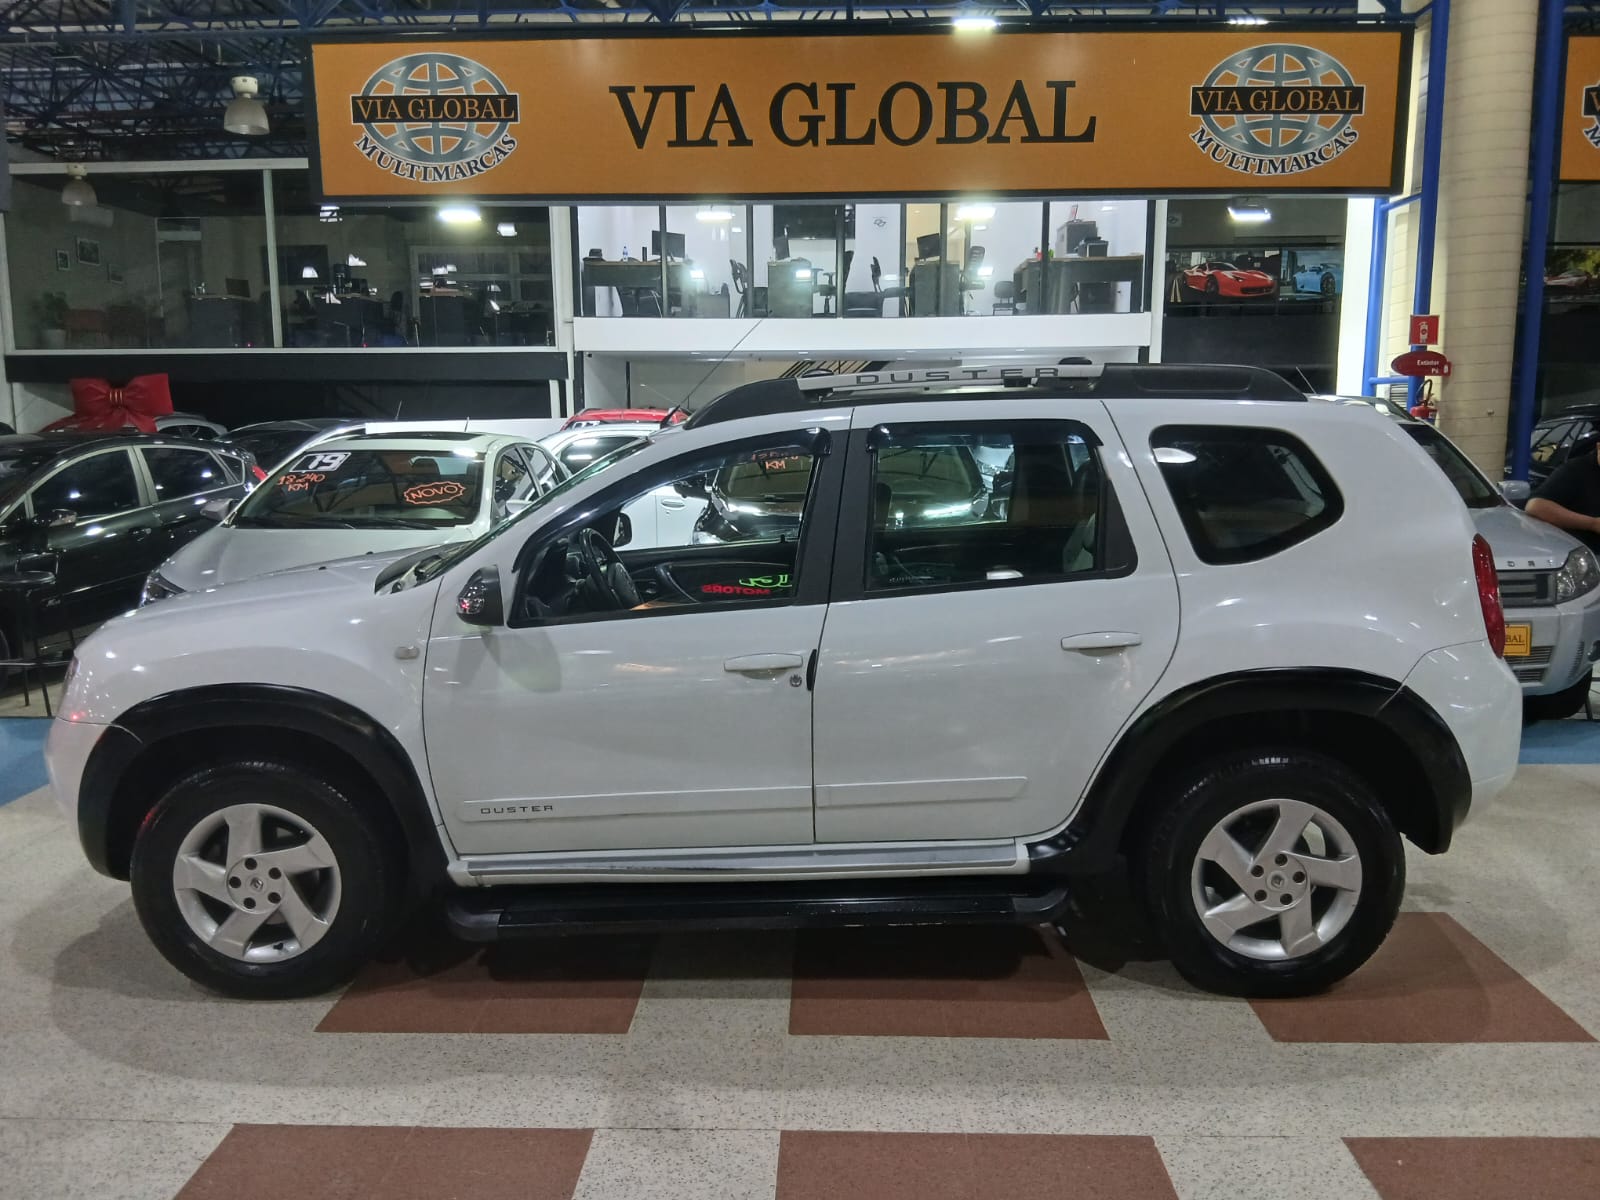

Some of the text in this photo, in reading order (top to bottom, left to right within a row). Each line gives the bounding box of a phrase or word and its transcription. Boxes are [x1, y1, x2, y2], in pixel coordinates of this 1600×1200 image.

[356, 97, 515, 120] VIA GLOBAL
[1196, 89, 1360, 112] VIA GLOBAL
[608, 79, 1097, 149] VIA GLOBAL
[355, 133, 517, 183] MULTIMARCAS
[1191, 125, 1359, 175] MULTIMARCAS
[855, 366, 1059, 385] DUSTER
[309, 455, 341, 470] 19
[765, 460, 786, 470] KM
[287, 482, 309, 492] KM
[411, 484, 458, 500] NOVO
[1505, 634, 1526, 643] BAL
[480, 805, 553, 814] DUSTER
